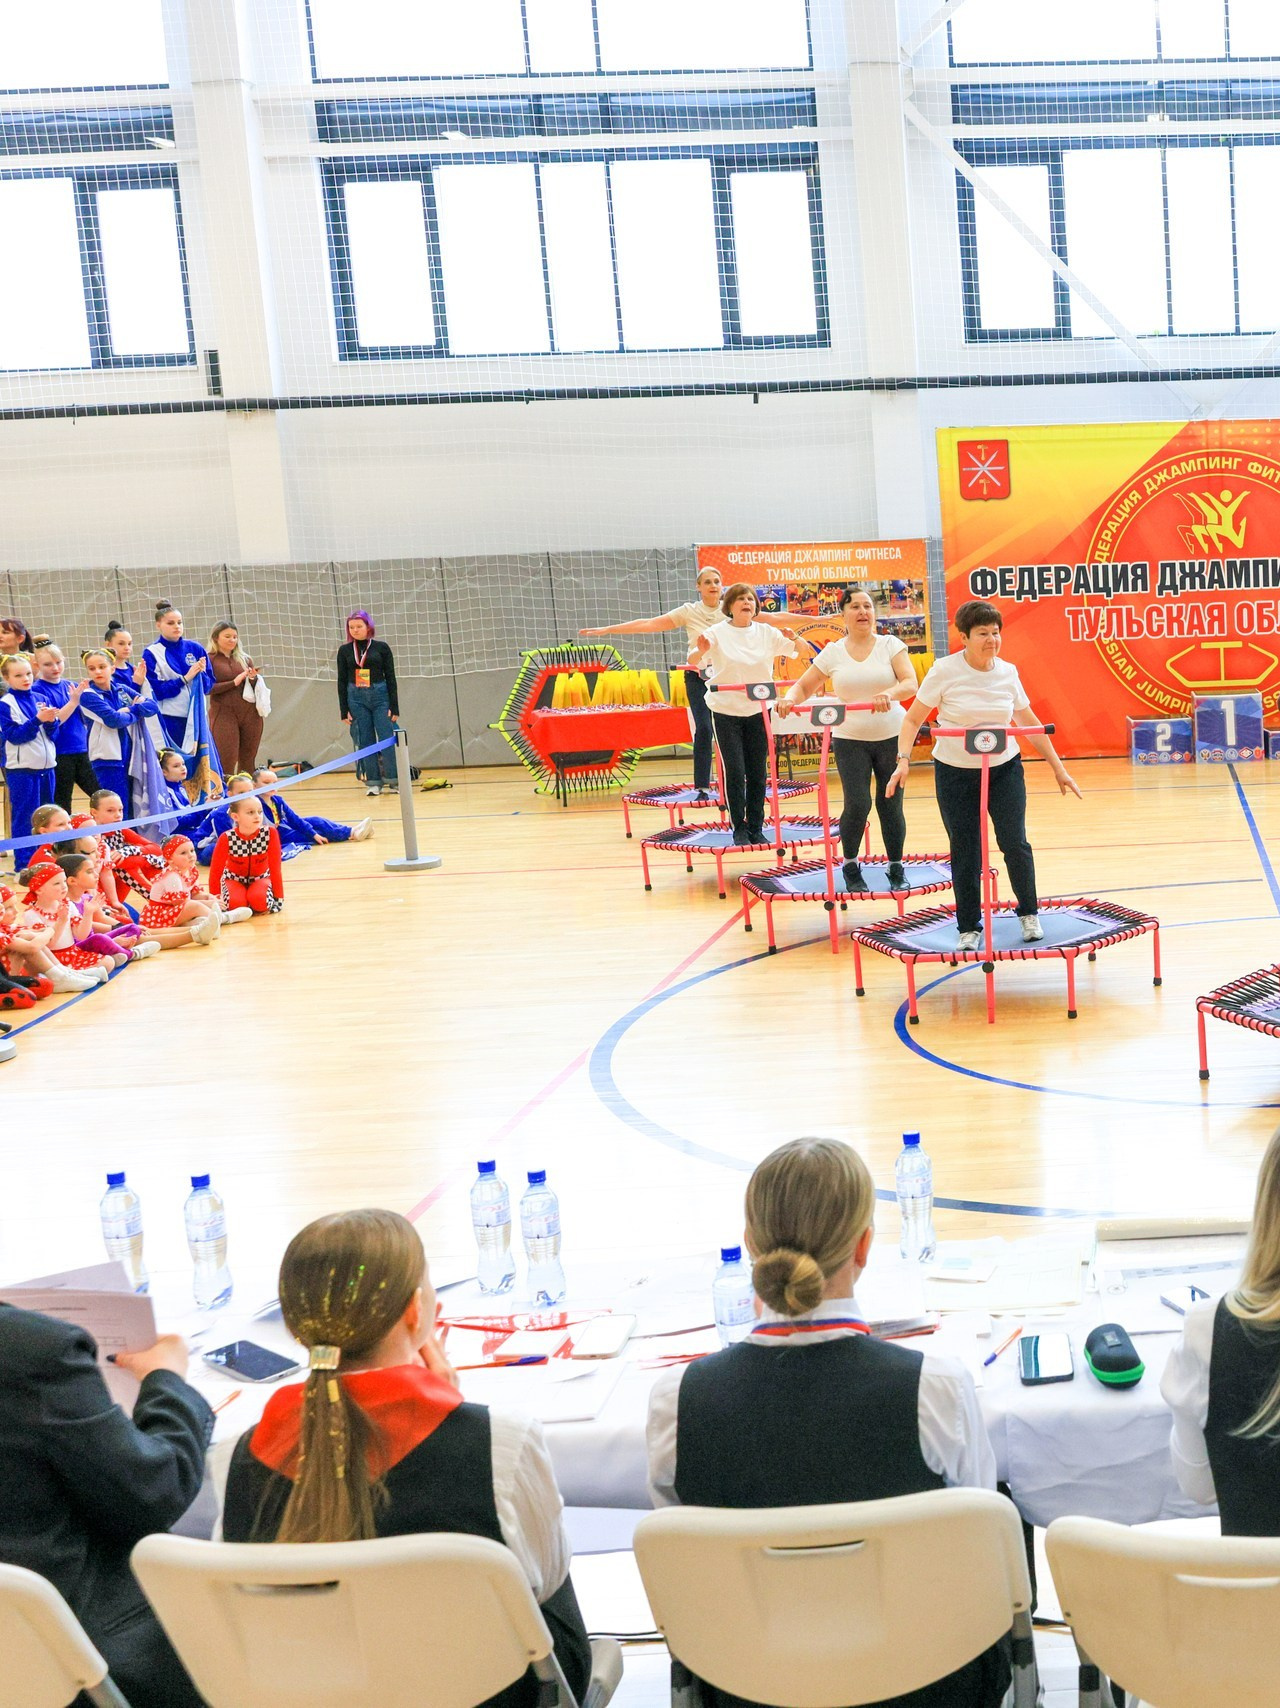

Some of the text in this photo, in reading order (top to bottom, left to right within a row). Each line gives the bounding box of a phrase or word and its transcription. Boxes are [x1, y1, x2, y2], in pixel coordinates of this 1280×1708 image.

[1094, 490, 1142, 563] ДЕРАЦИЯ
[1143, 457, 1242, 495] ДЖАМПИНГ
[728, 547, 902, 565] ФЕДЕРАЦИЯ ДЖАМПИНГ ФИТНЕСА
[766, 565, 868, 581] ТУЛЬСКОЙ ОБЛАСТИ
[969, 562, 1149, 602] ФЕДЕРАЦИЯ
[1065, 602, 1227, 641] ТУЛЬСКАЯ
[1101, 637, 1193, 714] SIAN JUMPI
[1156, 723, 1172, 752] 2
[1221, 699, 1236, 746] 1
[791, 757, 820, 767] ФЕДЕРАЦ
